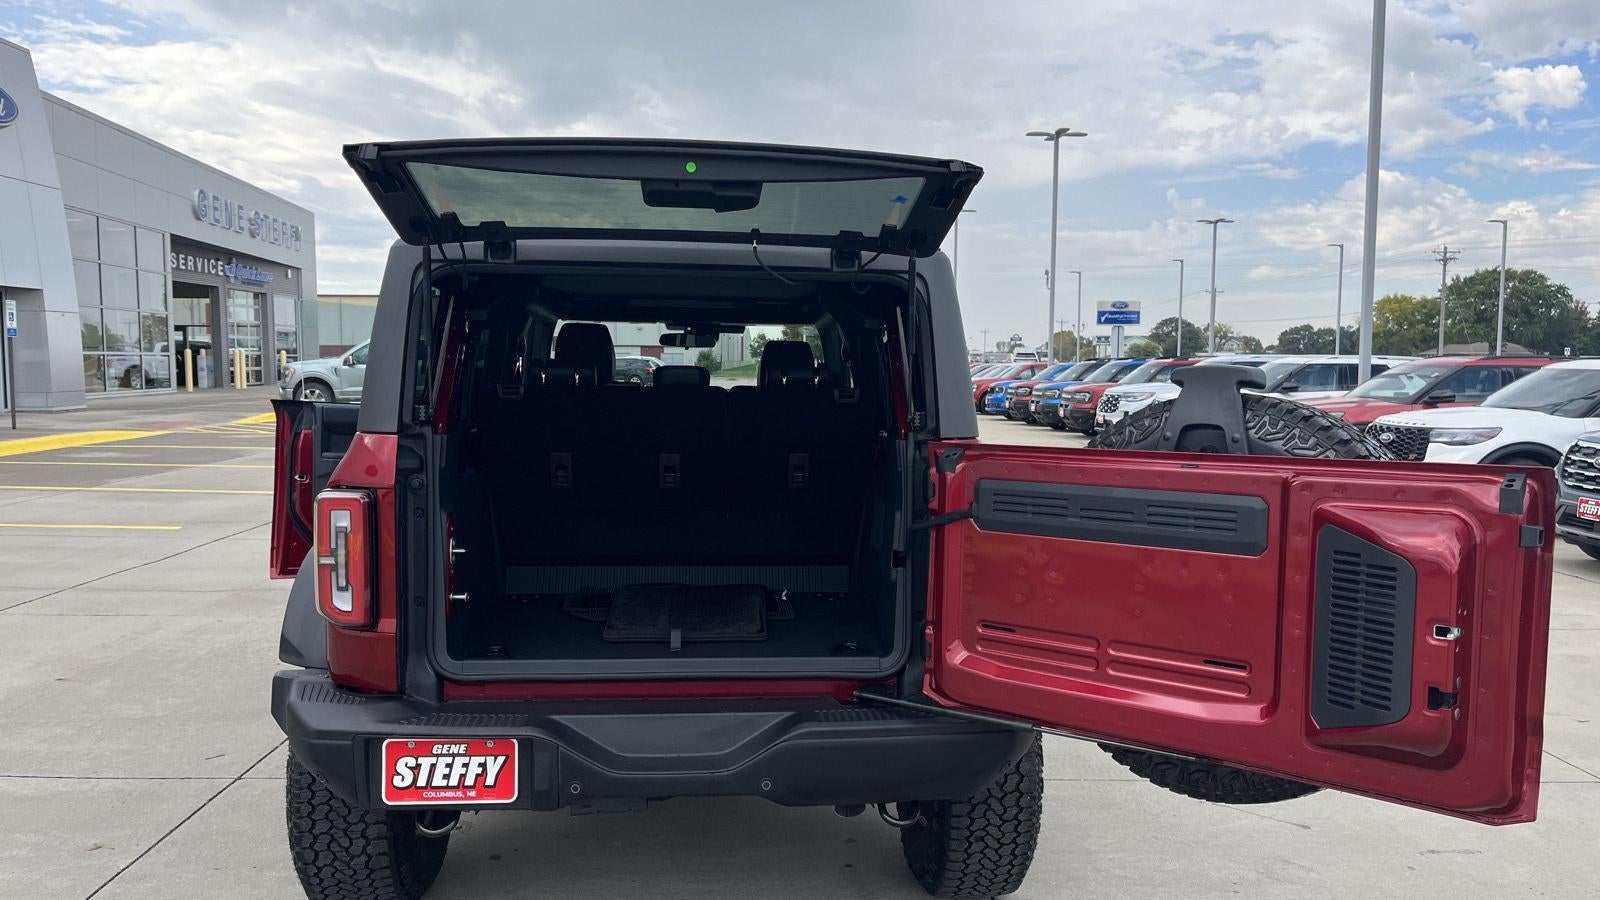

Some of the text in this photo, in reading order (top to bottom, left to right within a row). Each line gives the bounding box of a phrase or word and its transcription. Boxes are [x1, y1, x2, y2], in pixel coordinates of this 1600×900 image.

[193, 188, 303, 250] GENE STEFFY
[170, 252, 224, 276] SERVICE
[432, 744, 468, 754] GENE
[392, 755, 508, 789] STEFFY
